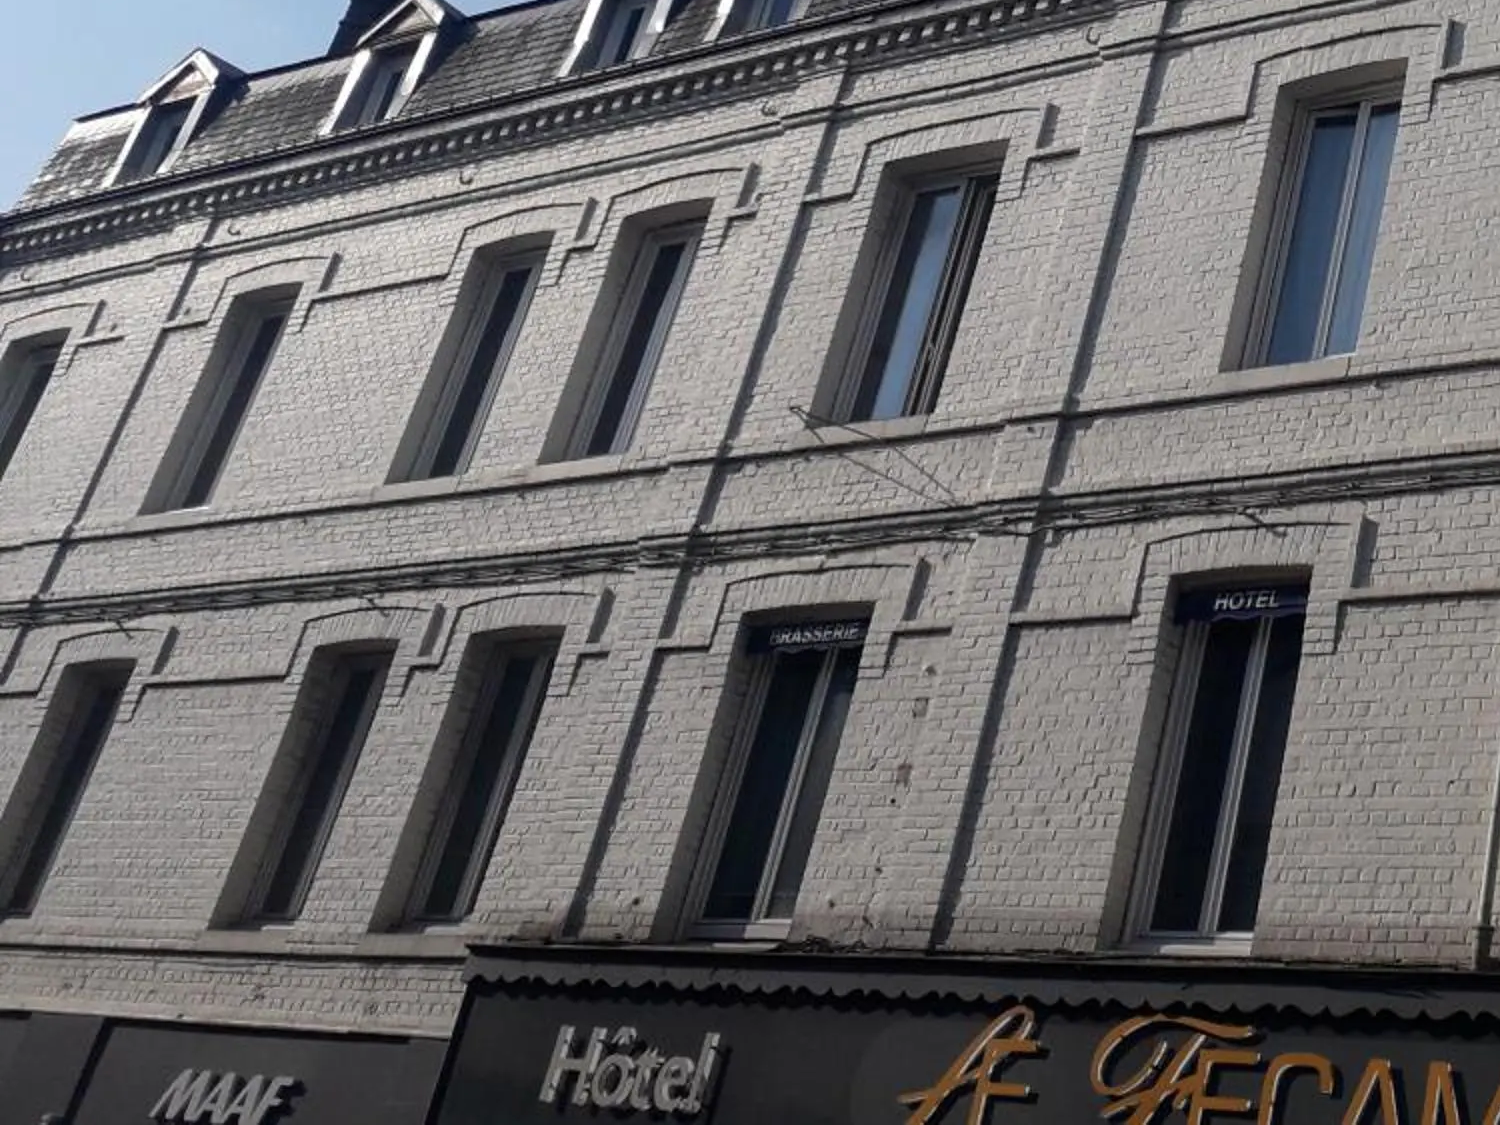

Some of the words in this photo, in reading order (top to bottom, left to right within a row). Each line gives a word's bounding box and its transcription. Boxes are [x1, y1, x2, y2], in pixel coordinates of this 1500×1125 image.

[1213, 589, 1280, 611] HOTEL
[769, 621, 860, 645] BRASSERIE
[538, 1024, 721, 1113] Hôtel
[148, 1068, 295, 1125] MAAF
